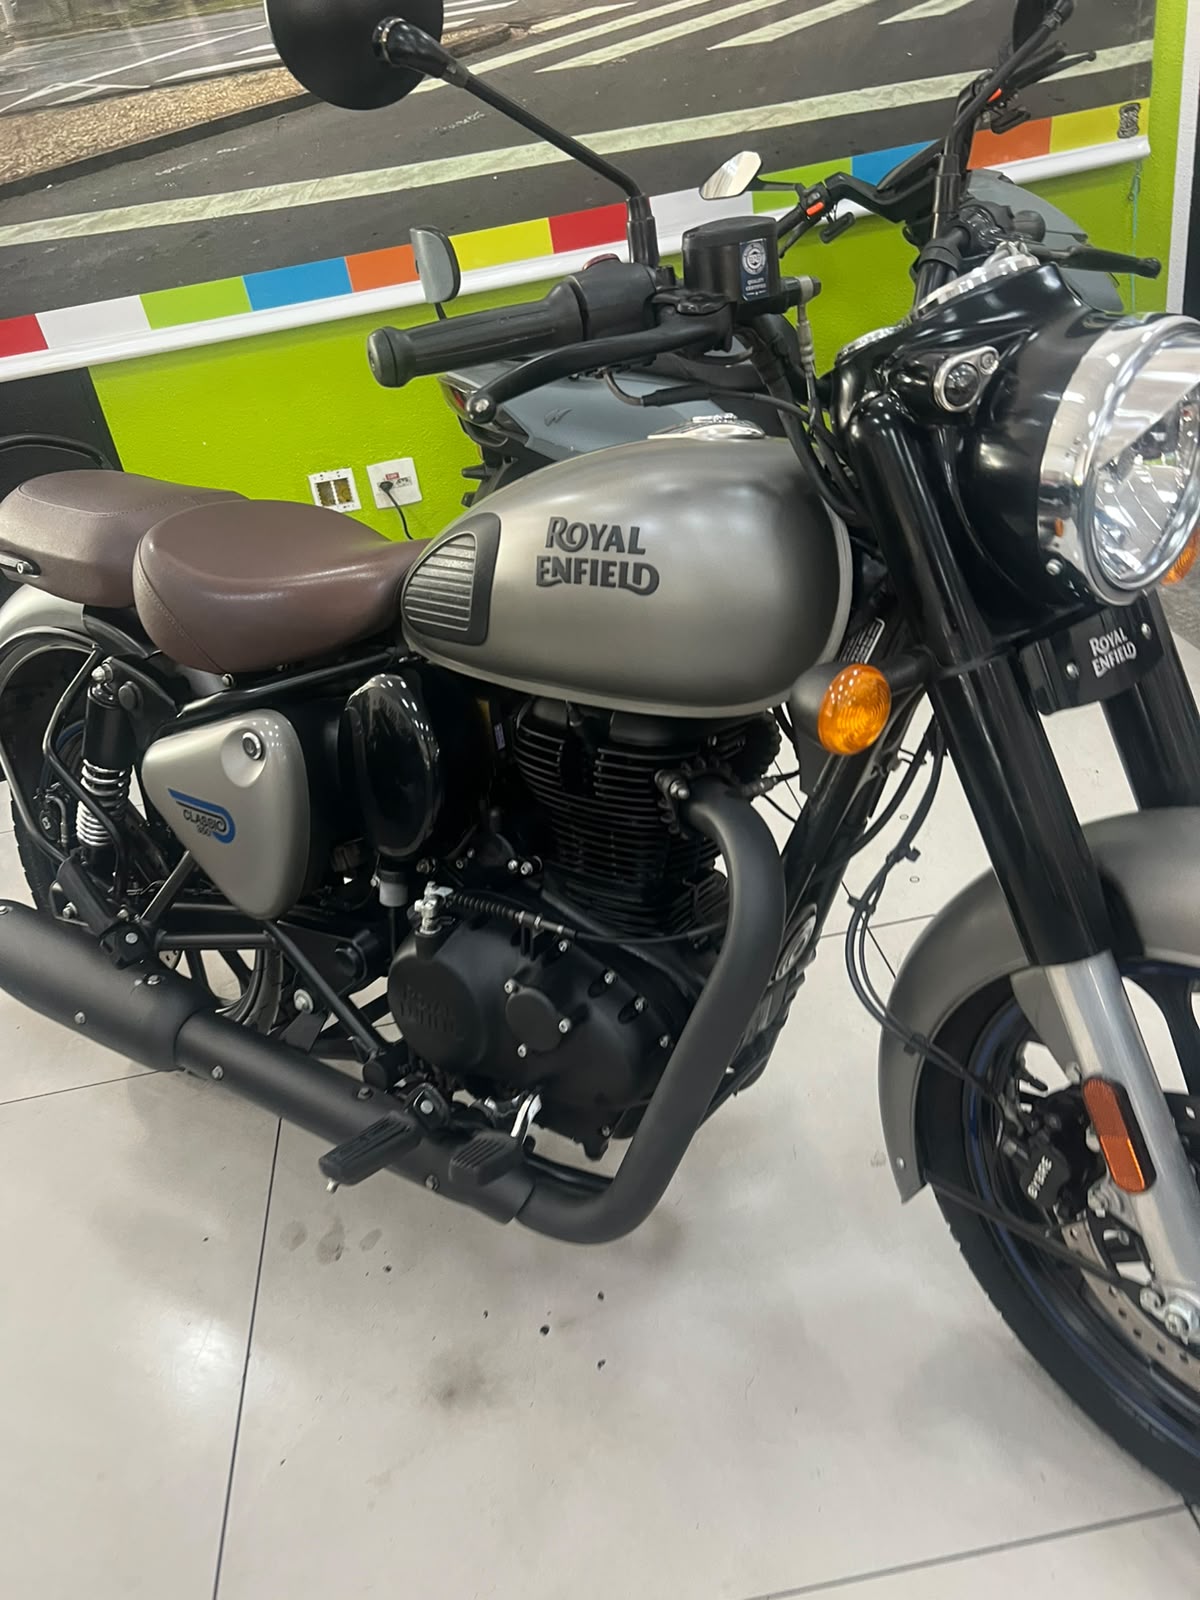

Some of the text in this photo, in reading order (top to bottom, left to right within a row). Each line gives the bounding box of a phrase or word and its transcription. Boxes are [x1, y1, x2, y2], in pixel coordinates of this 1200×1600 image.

[545, 516, 646, 555] ROYAL
[536, 555, 660, 596] ENFIELD
[1089, 626, 1128, 658] ROYAL
[1091, 641, 1137, 679] ENFIELD
[183, 809, 227, 833] CLASSIC
